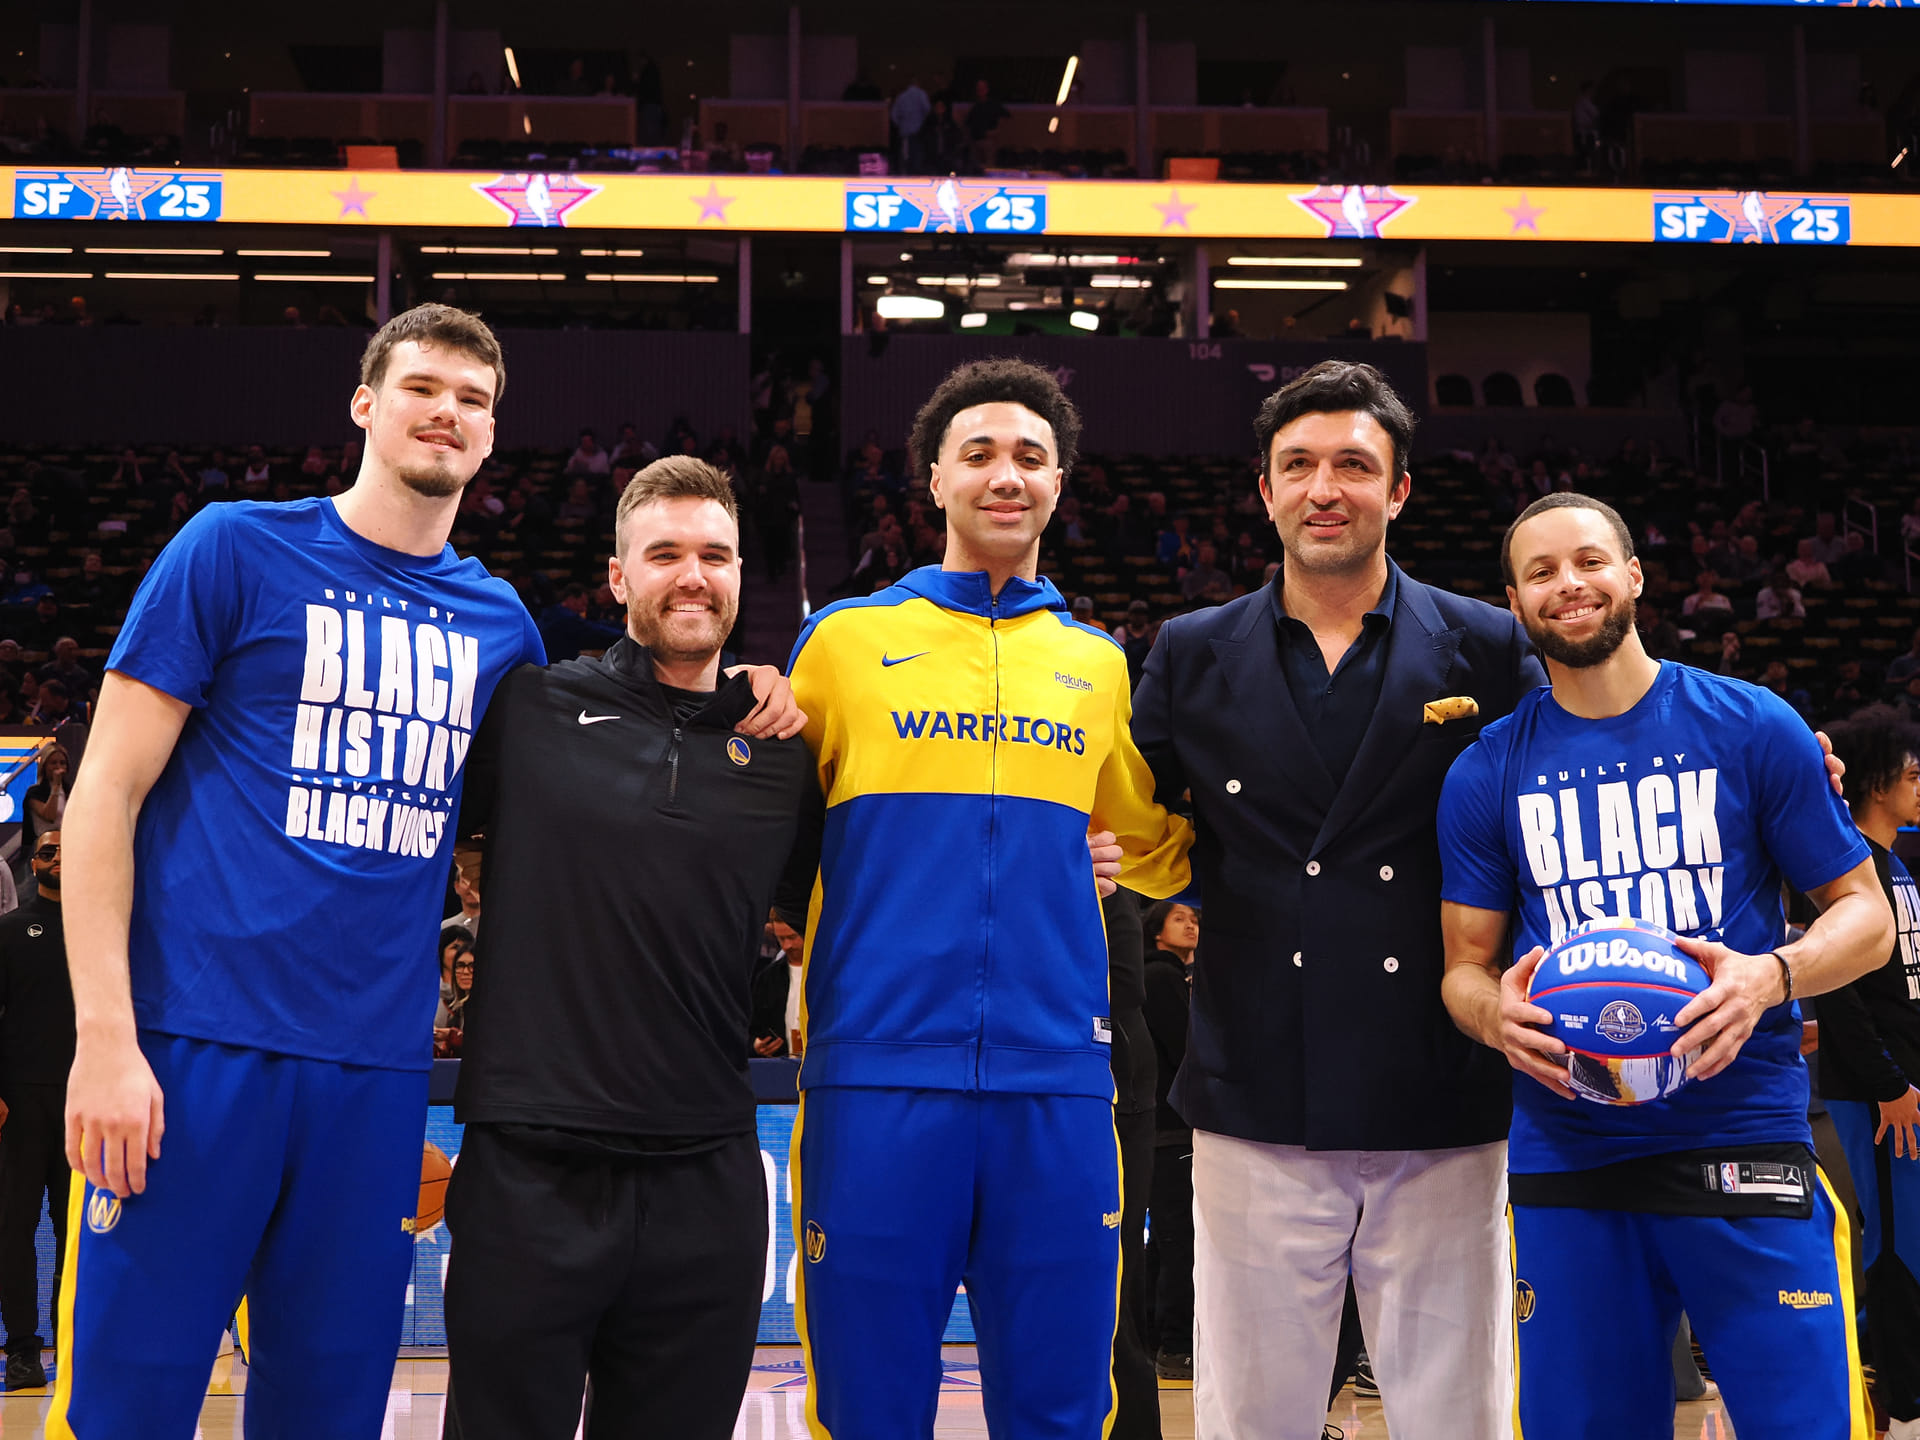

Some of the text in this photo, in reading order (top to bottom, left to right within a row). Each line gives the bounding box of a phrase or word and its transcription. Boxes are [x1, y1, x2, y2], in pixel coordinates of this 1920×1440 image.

[23, 182, 211, 218] SF 25
[853, 194, 1036, 231] SF 25
[1661, 205, 1840, 242] SF 25
[1189, 343, 1222, 359] 104
[324, 588, 454, 624] BUILT BY
[300, 604, 479, 730] BLACK
[1055, 671, 1093, 692] Rakuten
[291, 703, 472, 791] HISTORY
[890, 710, 1086, 756] WARRIORS
[1537, 753, 1685, 785] BUILT BY
[285, 786, 389, 851] BLACK
[1517, 768, 1722, 887] BLACK
[1542, 866, 1724, 949] HISTORY
[1557, 938, 1688, 983] Wilson
[1778, 1289, 1833, 1309] Rakuten
